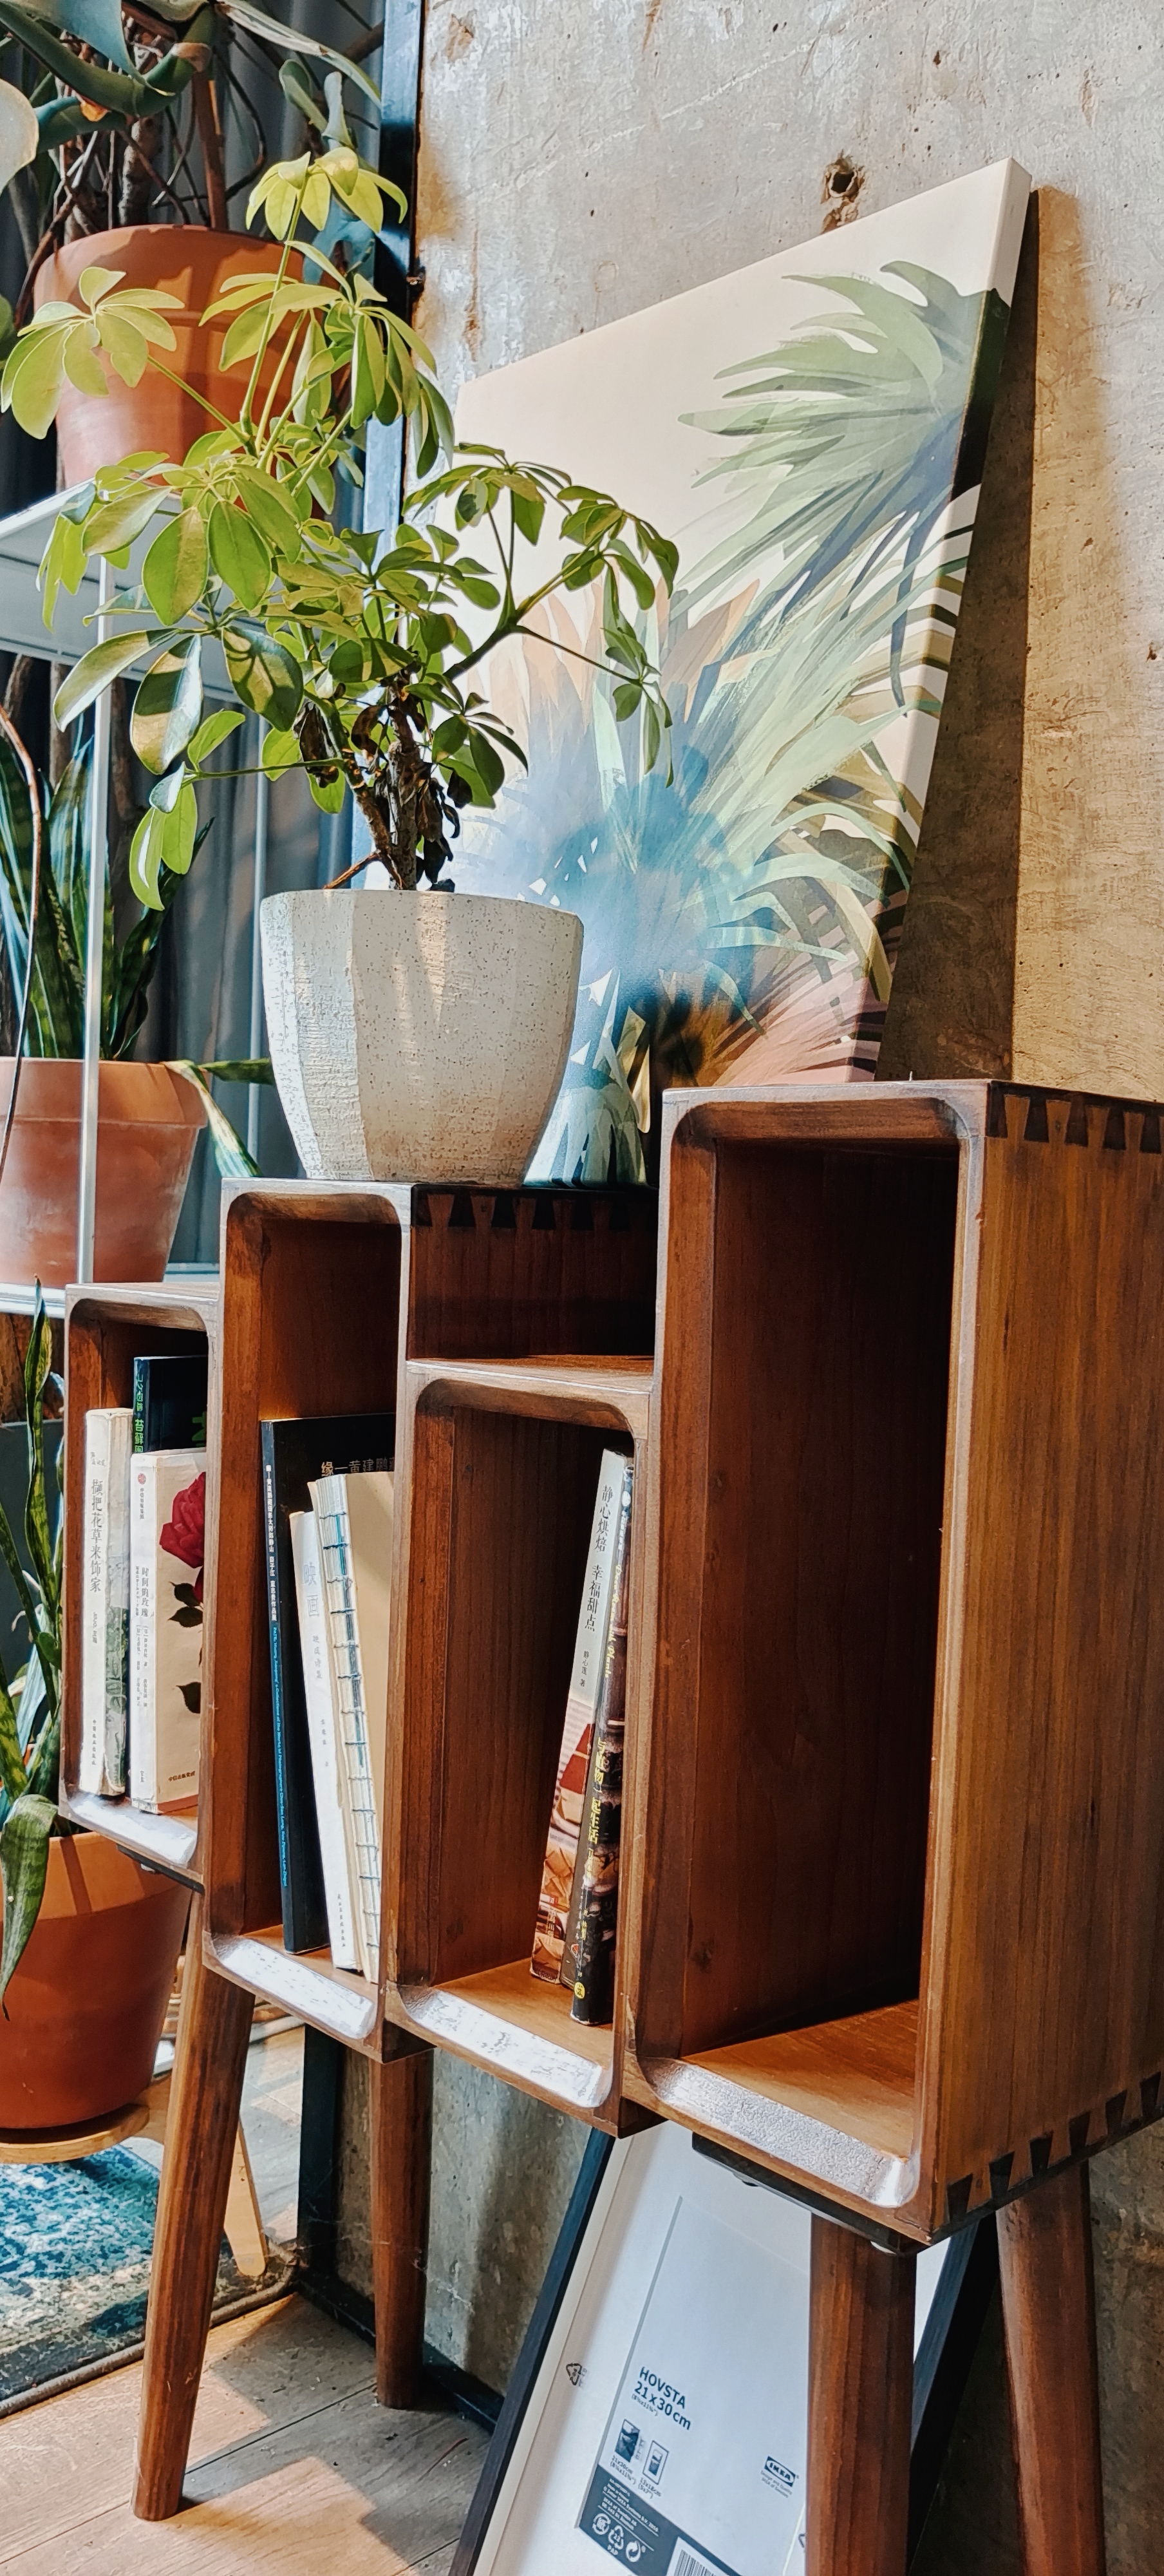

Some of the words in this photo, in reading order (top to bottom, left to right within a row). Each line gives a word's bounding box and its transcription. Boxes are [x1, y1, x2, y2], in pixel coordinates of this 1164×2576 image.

[594, 1484, 614, 1553] 静心烘焙
[141, 1567, 149, 1617] 时间的玫瑰
[584, 1564, 604, 1632] 幸福甜点
[588, 1736, 606, 1846] 与植物一起生活
[639, 2366, 686, 2410] HOVSTA
[768, 2461, 792, 2483] IKEA
